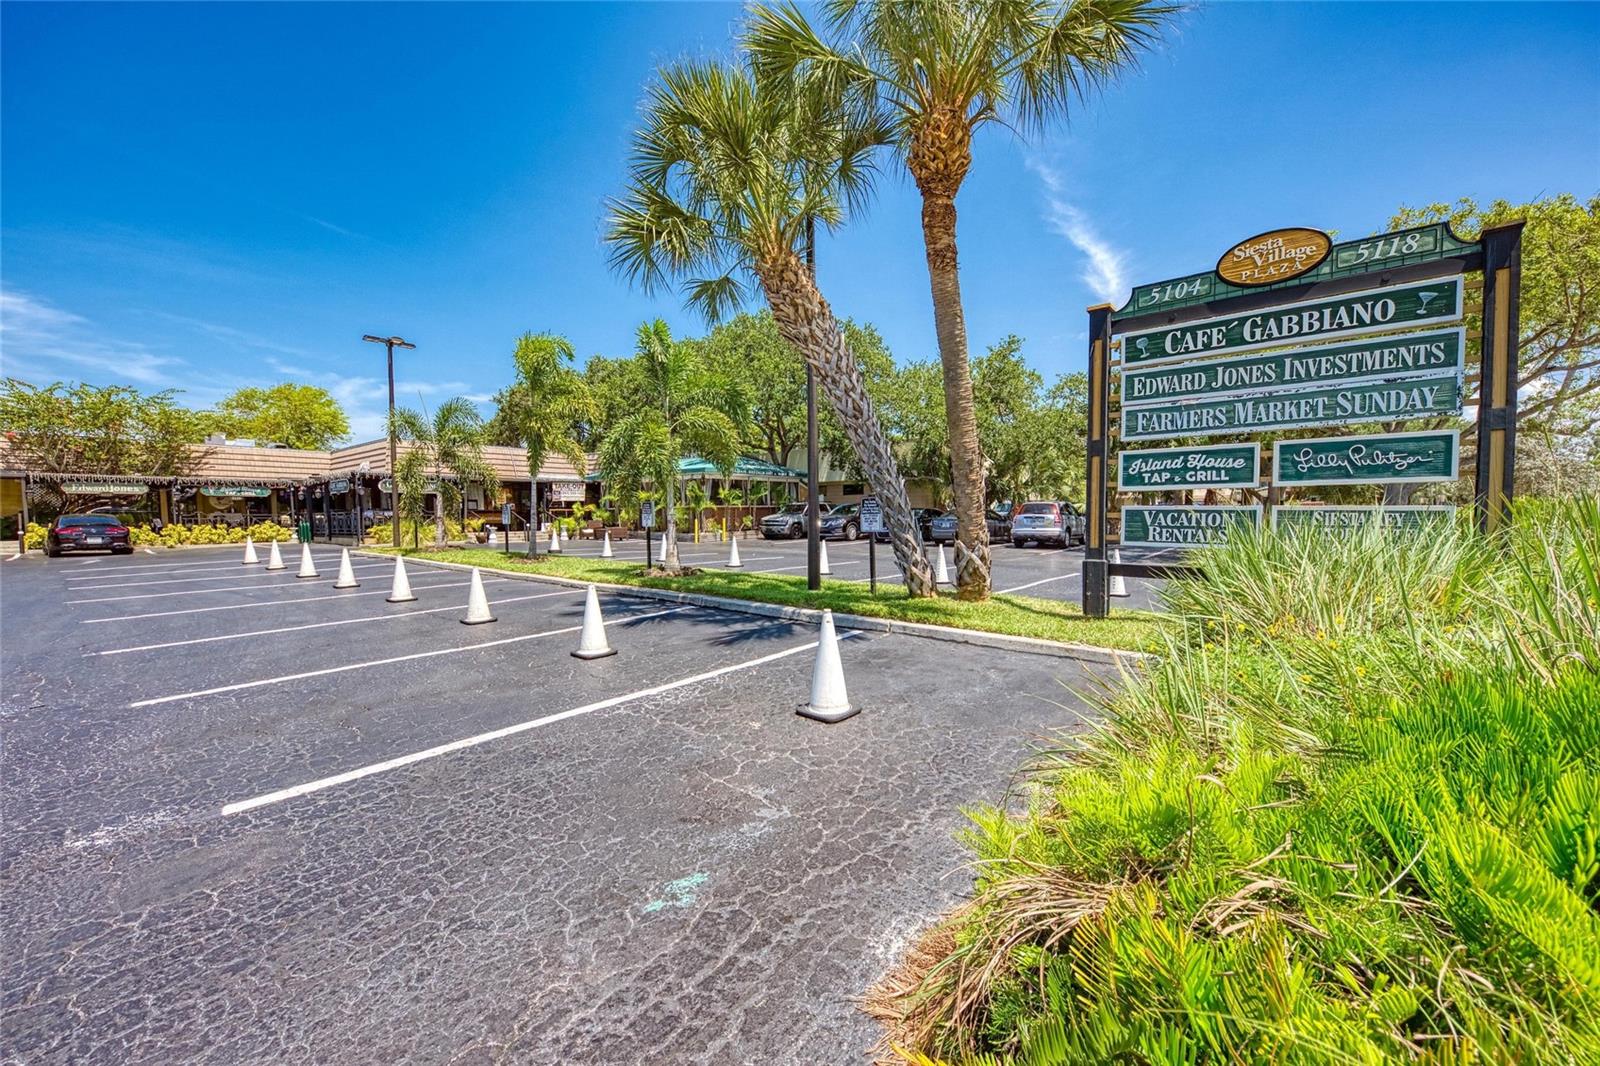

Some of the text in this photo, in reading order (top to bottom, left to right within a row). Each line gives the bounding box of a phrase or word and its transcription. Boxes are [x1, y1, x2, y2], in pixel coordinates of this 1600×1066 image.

[1233, 238, 1283, 262] Siesta
[1253, 244, 1317, 267] Village
[1353, 233, 1420, 264] 5118
[1241, 261, 1303, 280] PLAZA
[1147, 278, 1202, 306] 5104
[1242, 299, 1396, 342] GABBIANO
[1133, 342, 1445, 397] EDWARD JONES INVESTMENTS
[1136, 386, 1440, 433] FARMERS MARKET SUNDAY
[1128, 454, 1246, 475] Island House
[1293, 444, 1434, 475] Lilly Pulitzer
[1142, 472, 1171, 483] TAP
[1185, 469, 1229, 482] GRILL
[1143, 510, 1235, 528] VACATION
